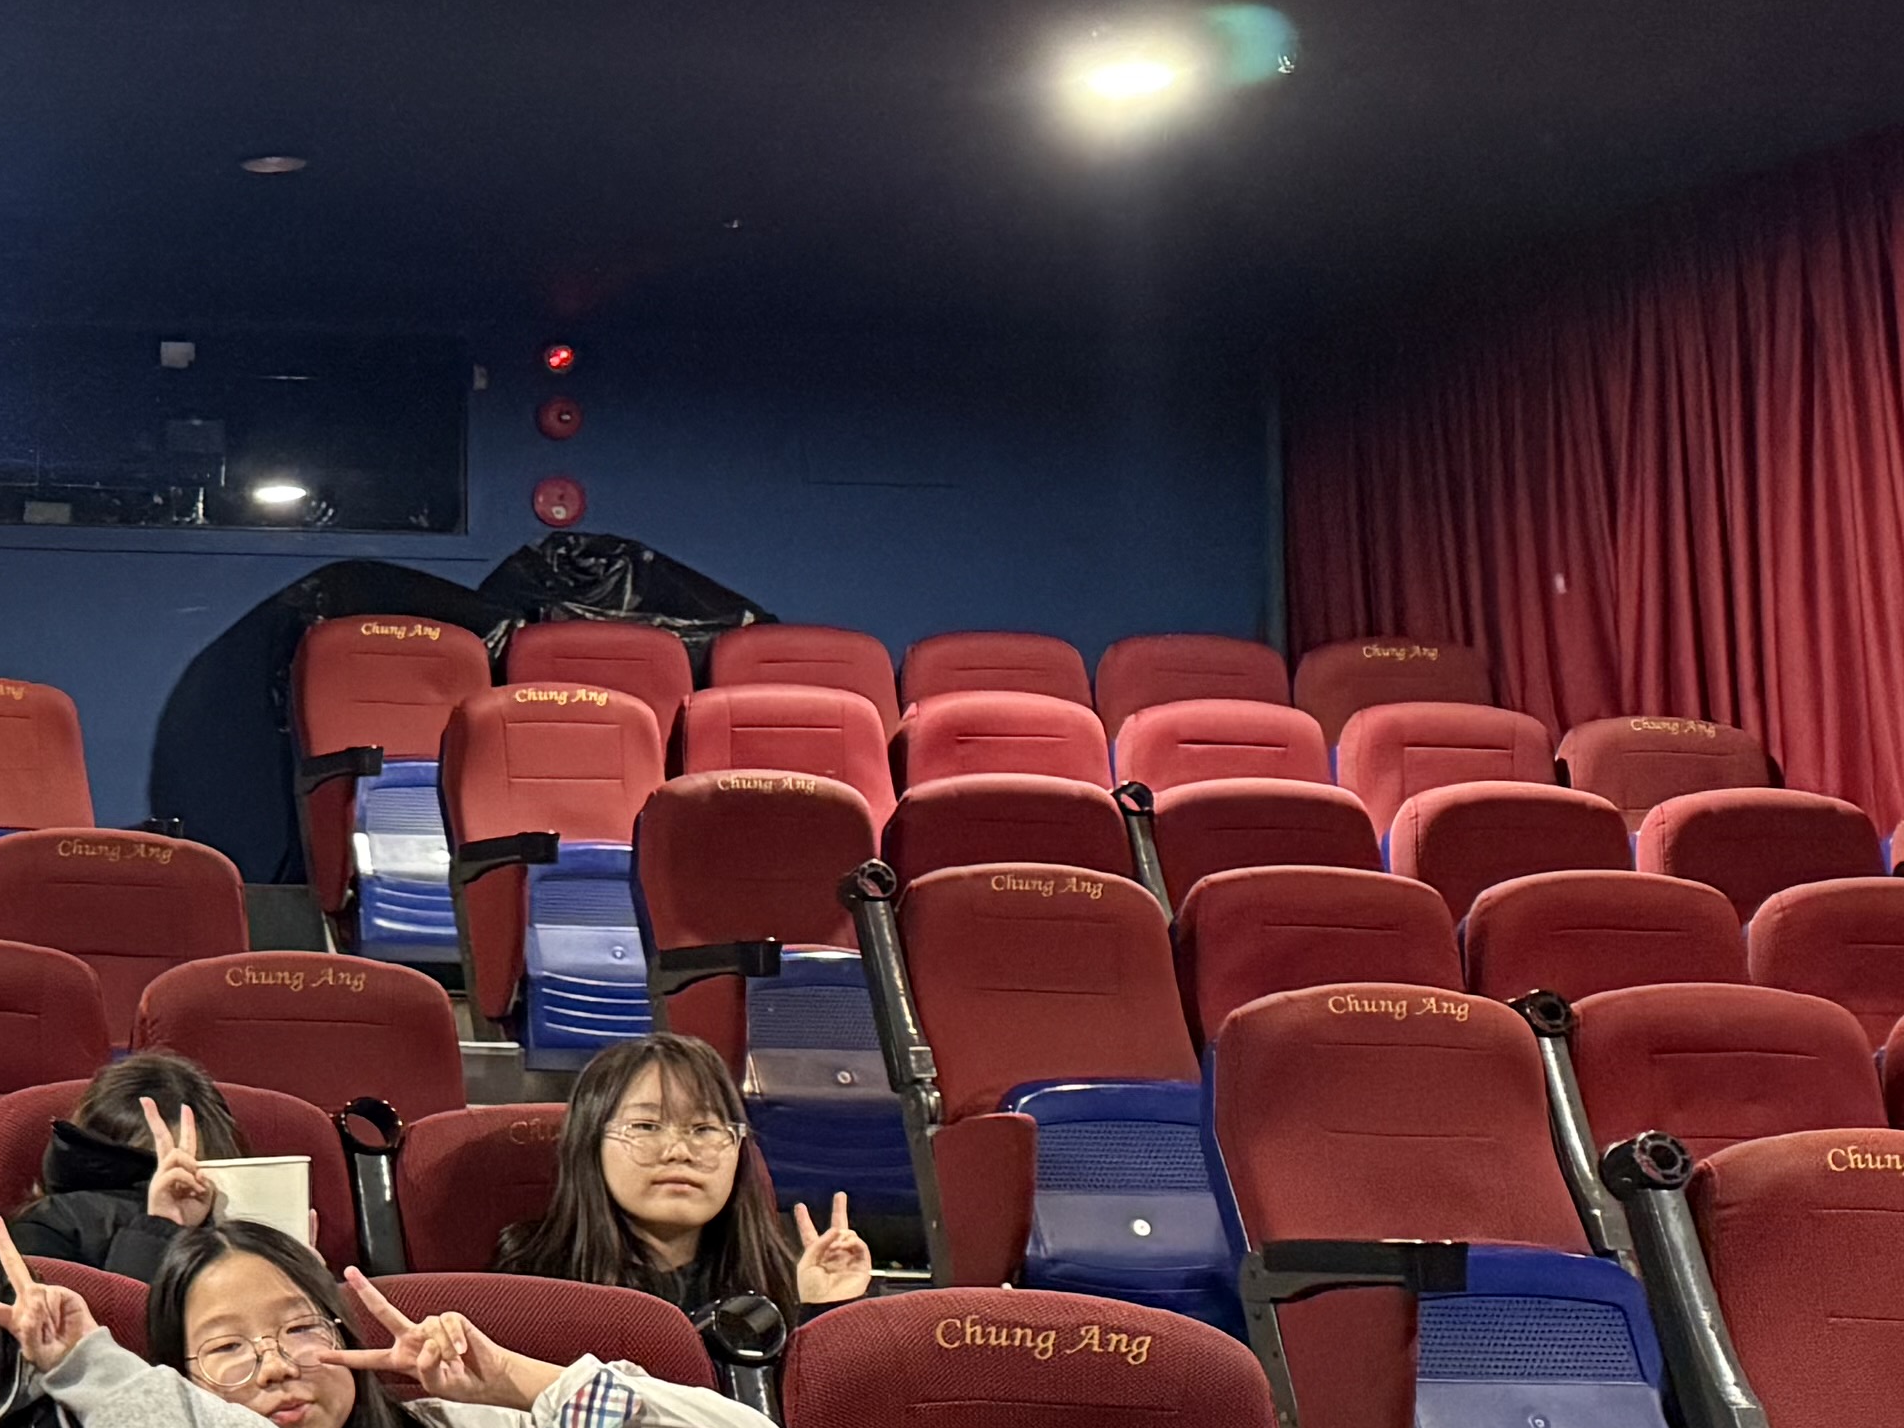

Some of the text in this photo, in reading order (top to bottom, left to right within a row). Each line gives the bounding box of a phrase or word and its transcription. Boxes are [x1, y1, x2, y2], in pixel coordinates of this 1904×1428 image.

[361, 622, 441, 641] Chung Ang
[1362, 644, 1439, 662] Chung Ang
[514, 686, 609, 707] Chung Ang
[717, 775, 816, 795] Chung Ang
[58, 838, 174, 865] Chung Ang
[992, 873, 1104, 900] Chung Ang
[225, 963, 366, 992] Chung Ang
[1328, 994, 1470, 1022] Chung Ang
[1827, 1145, 1904, 1177] Chun
[935, 1315, 1153, 1365] Chung Ang
